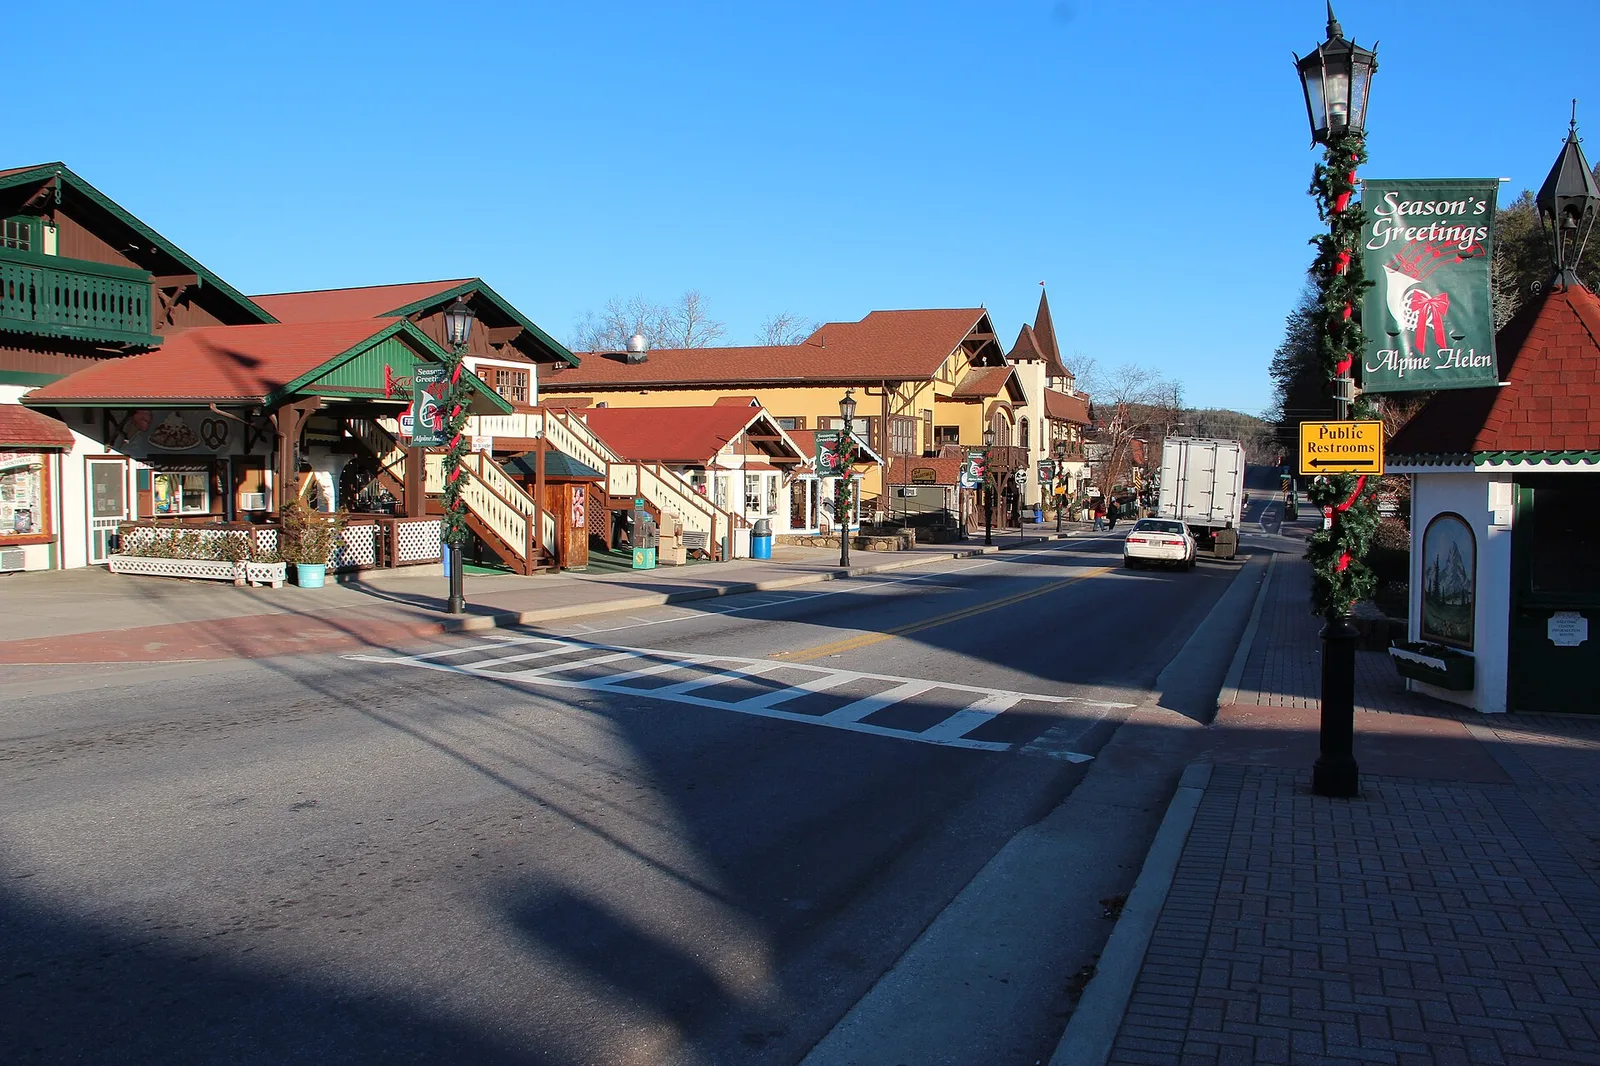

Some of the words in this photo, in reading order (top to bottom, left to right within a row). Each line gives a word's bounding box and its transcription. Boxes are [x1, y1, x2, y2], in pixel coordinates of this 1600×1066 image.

[1374, 192, 1486, 216] Season's
[1366, 218, 1488, 250] Greetings
[1365, 349, 1431, 378] Alpine
[1435, 348, 1492, 370] Helen
[1319, 427, 1363, 439] Public
[1307, 442, 1375, 453] Restrooms
